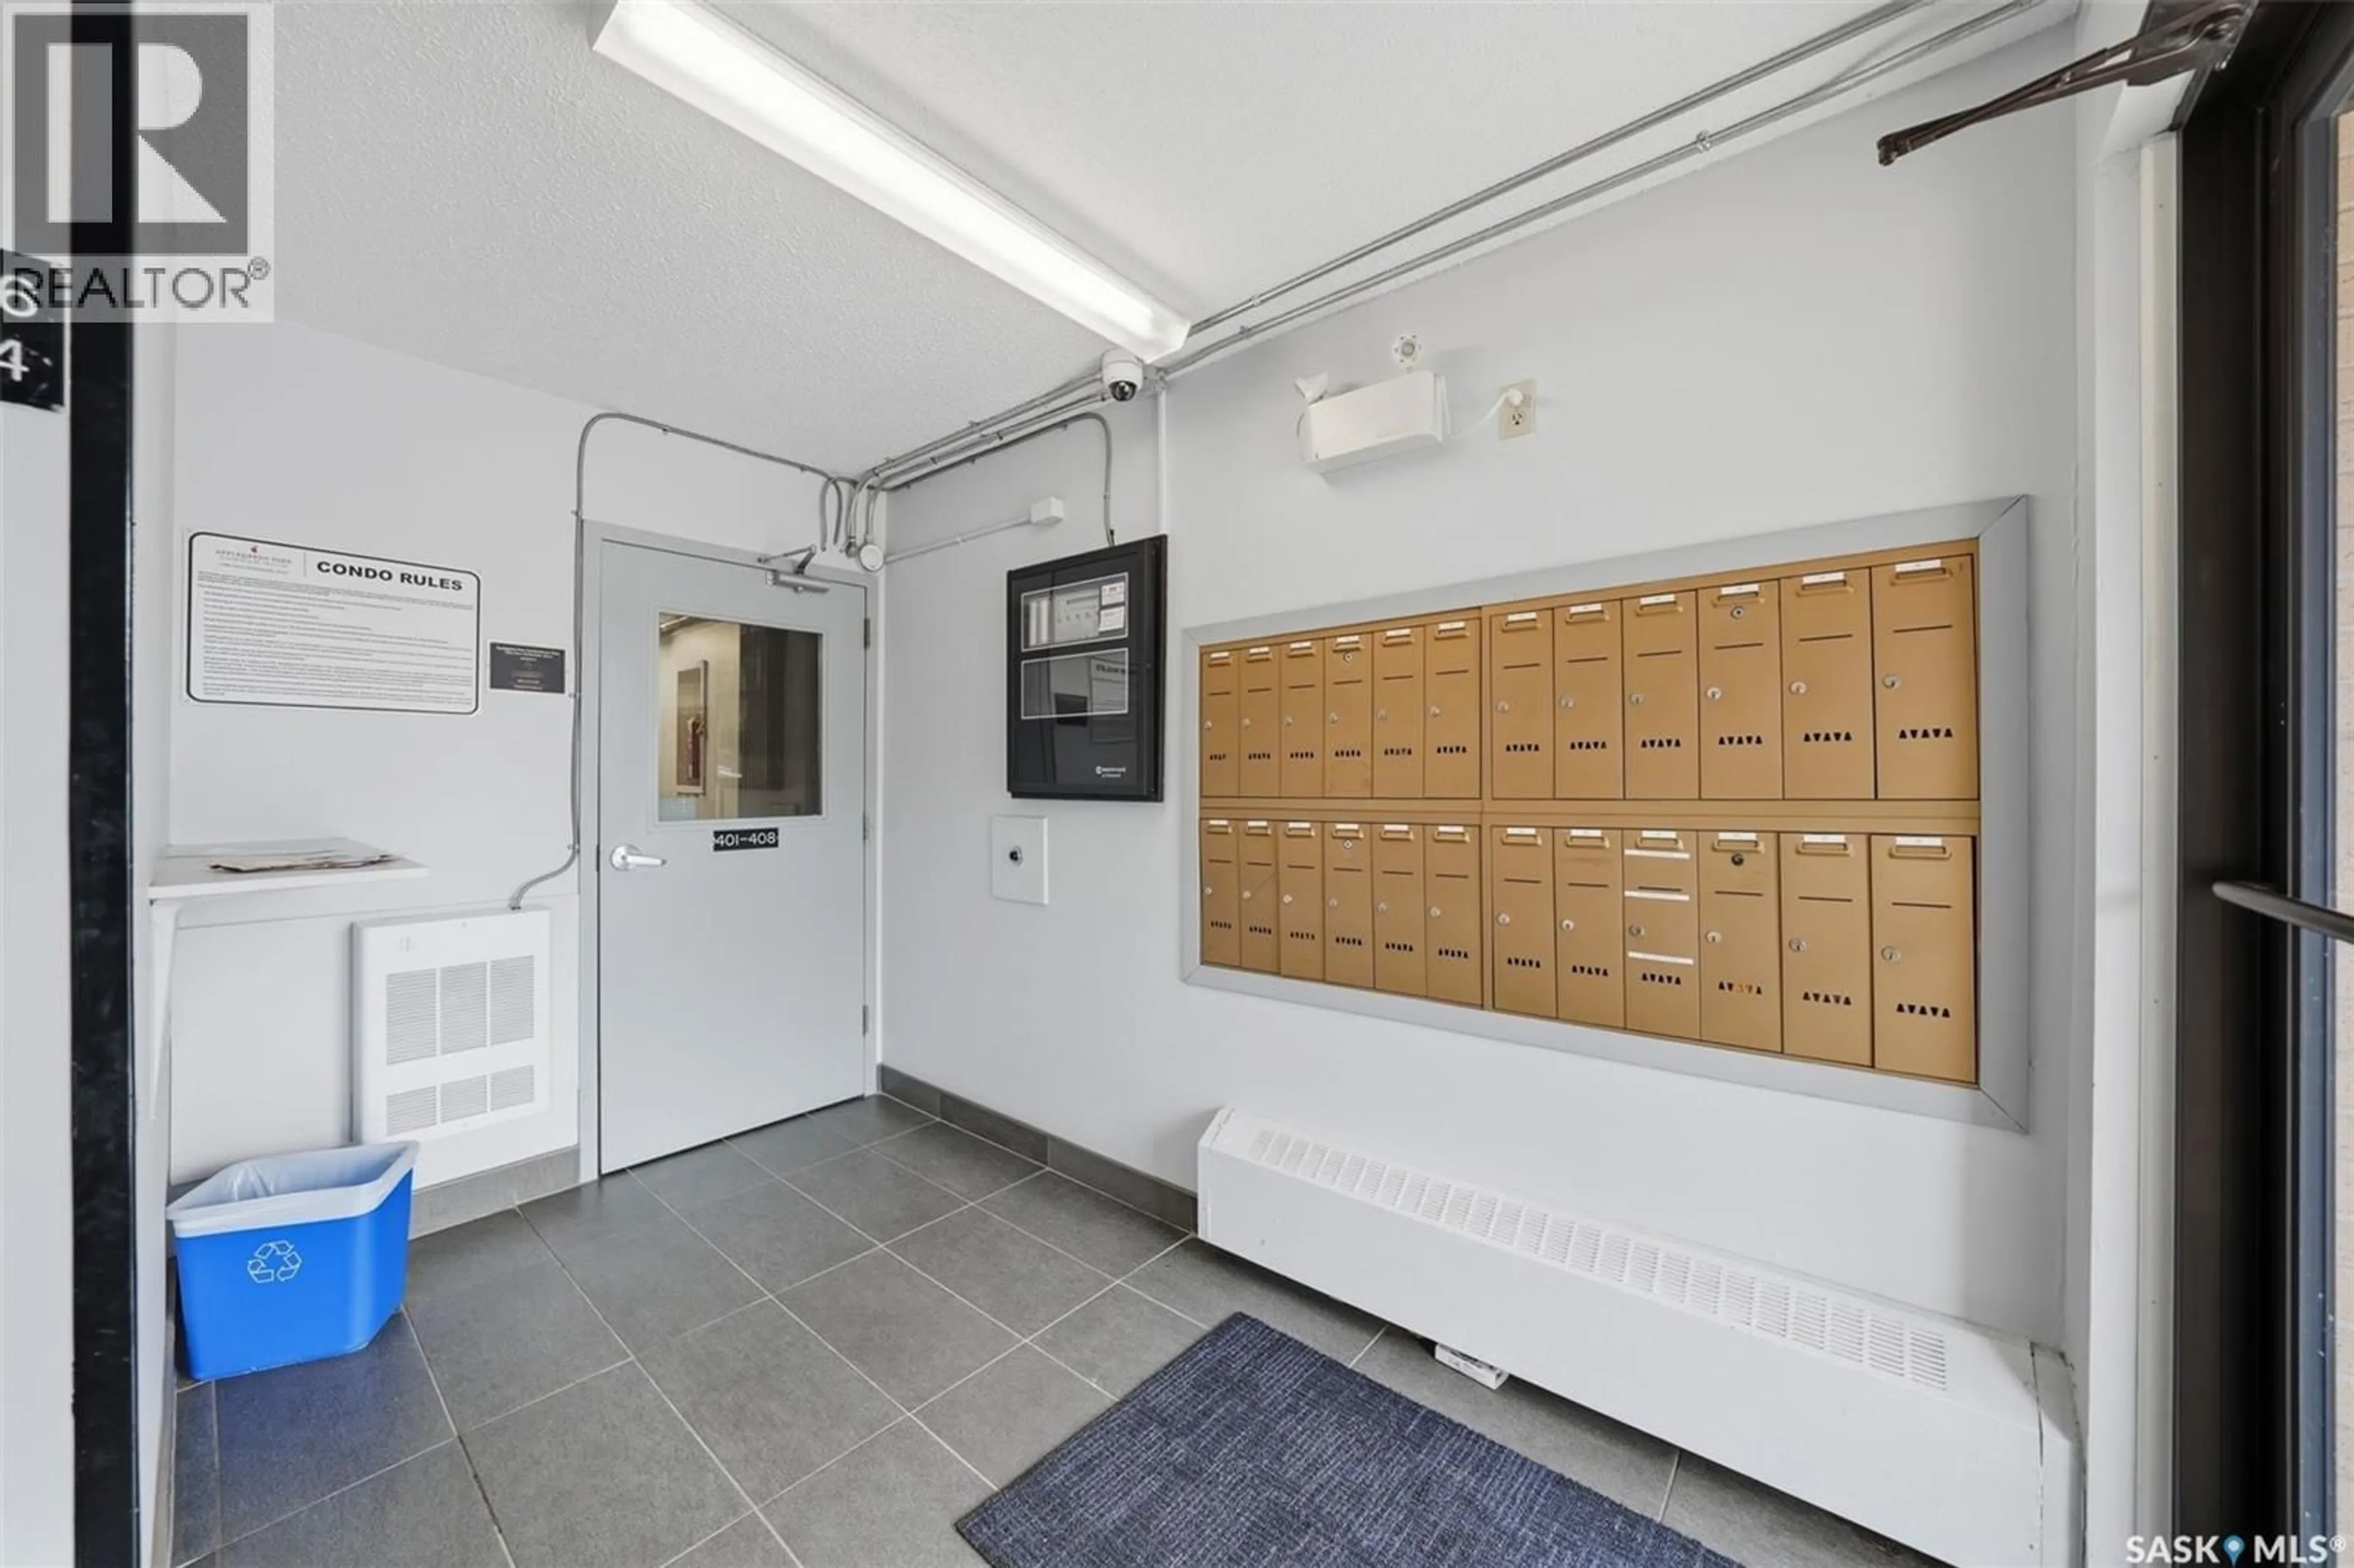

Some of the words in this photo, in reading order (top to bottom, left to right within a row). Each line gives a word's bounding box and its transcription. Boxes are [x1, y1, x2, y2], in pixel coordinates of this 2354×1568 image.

[0, 338, 29, 381] 4
[317, 561, 392, 581] CONDO
[400, 573, 462, 591] RULES
[714, 832, 776, 847] 401-408
